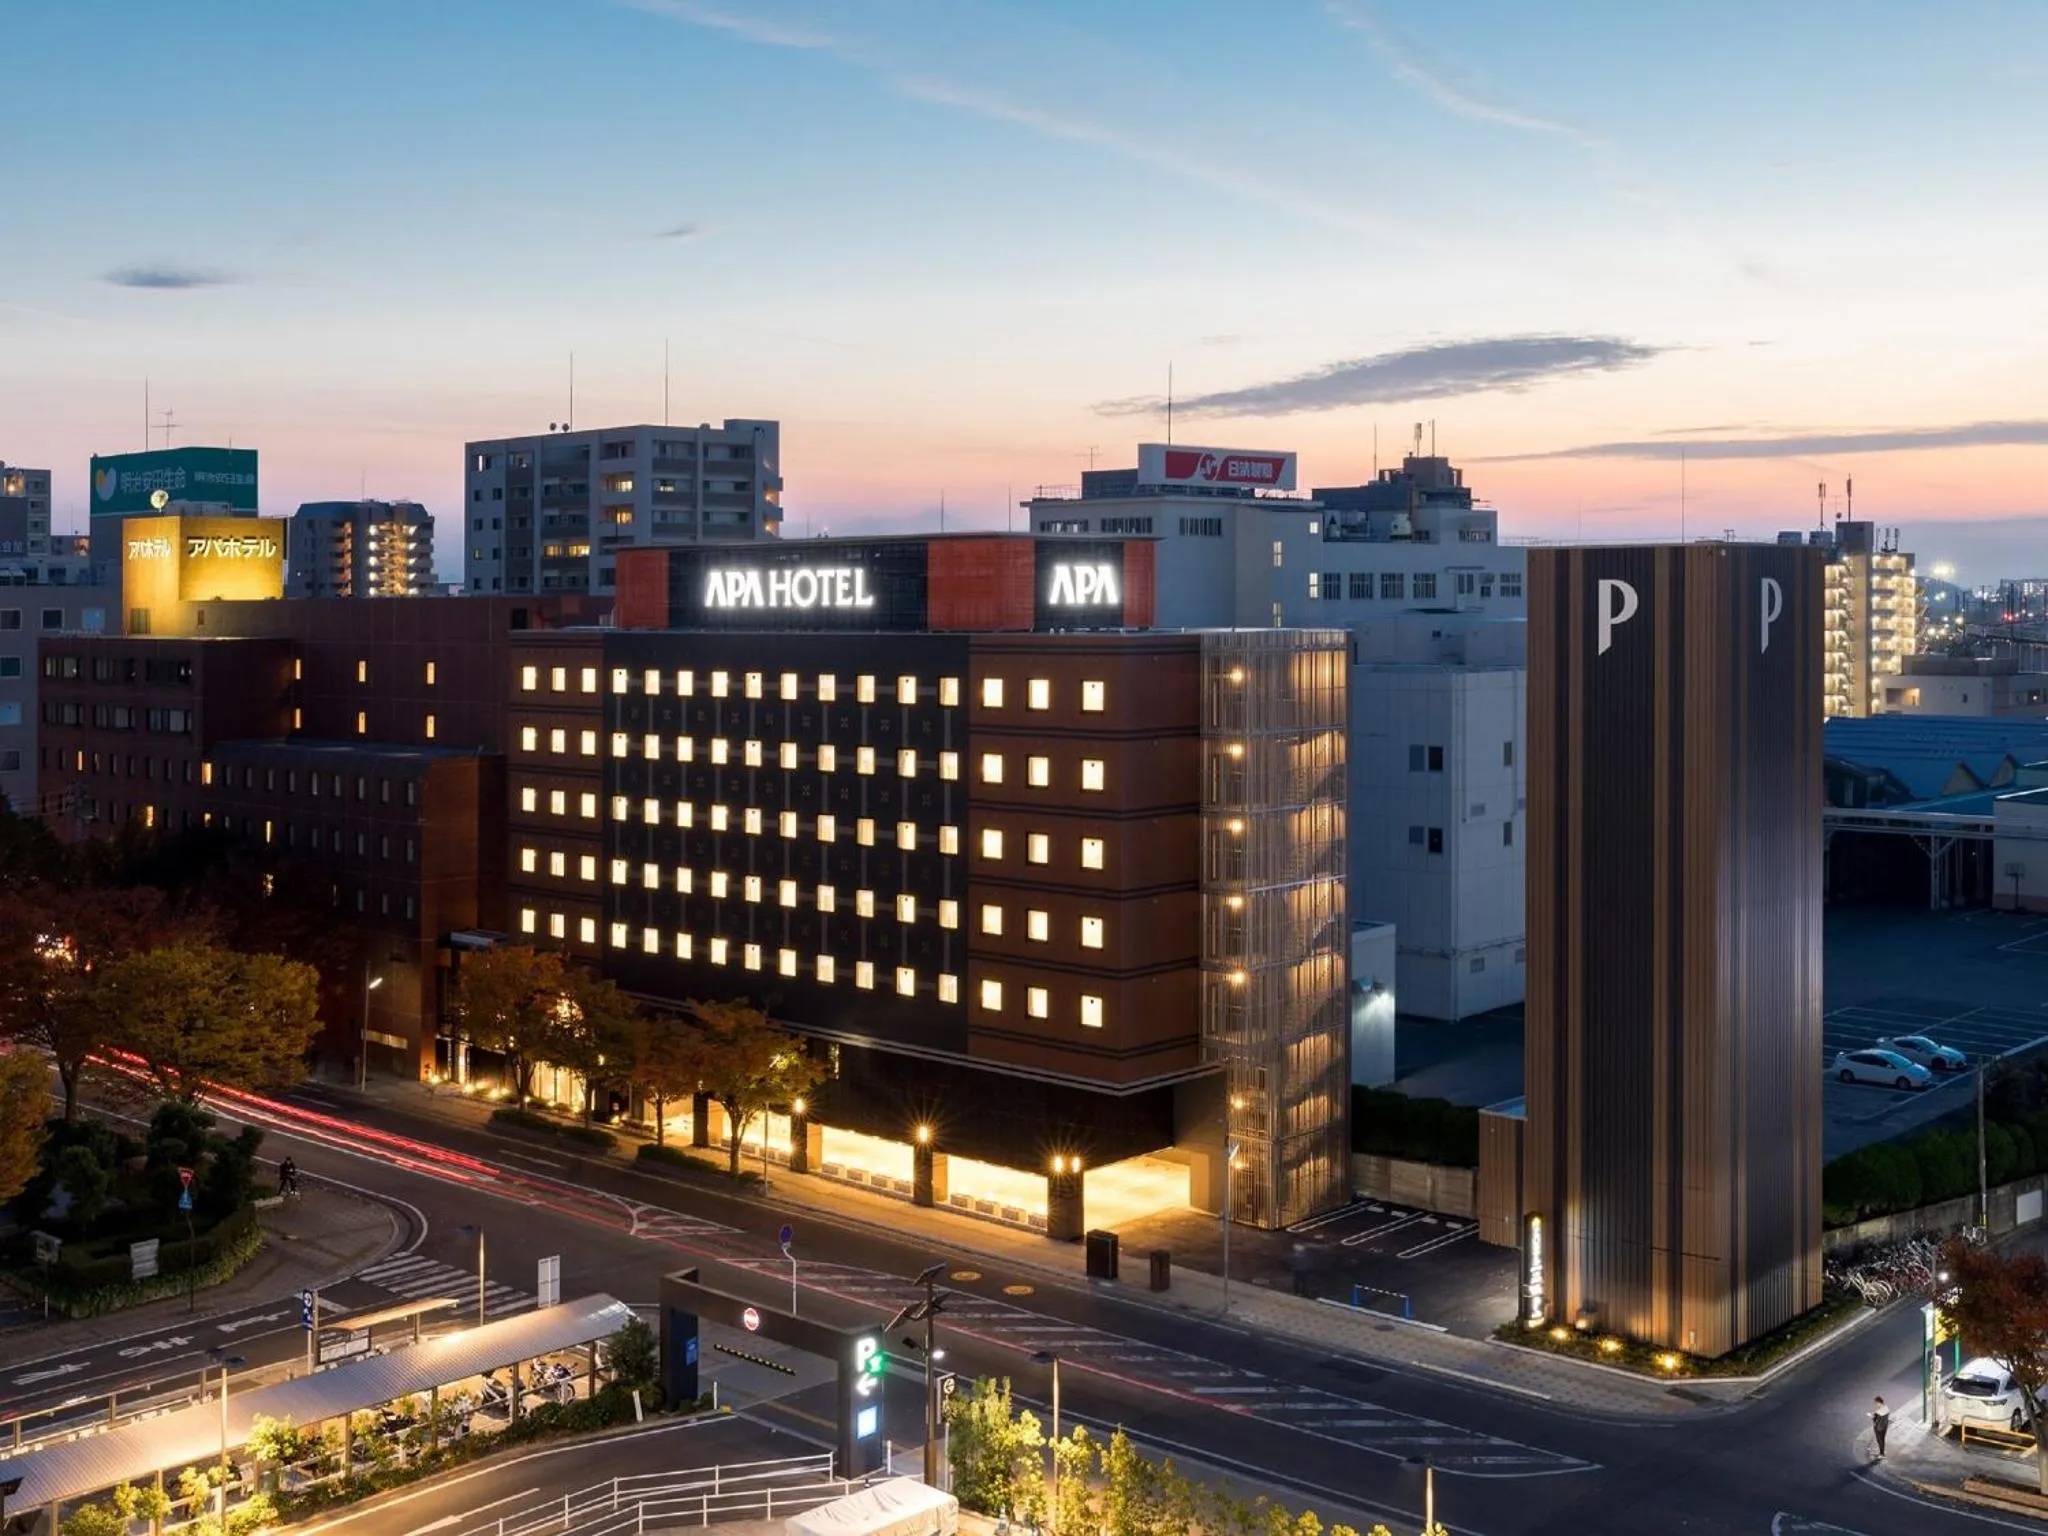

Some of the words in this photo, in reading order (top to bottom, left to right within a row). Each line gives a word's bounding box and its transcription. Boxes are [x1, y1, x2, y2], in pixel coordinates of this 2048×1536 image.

[128, 538, 171, 559] アパホテル
[187, 537, 276, 558] アパホテル
[705, 570, 763, 607] APA
[769, 568, 873, 607] HOTEL
[1049, 566, 1118, 605] APA
[1598, 579, 1638, 656] P
[1761, 578, 1782, 654] P
[857, 1338, 876, 1372] P
